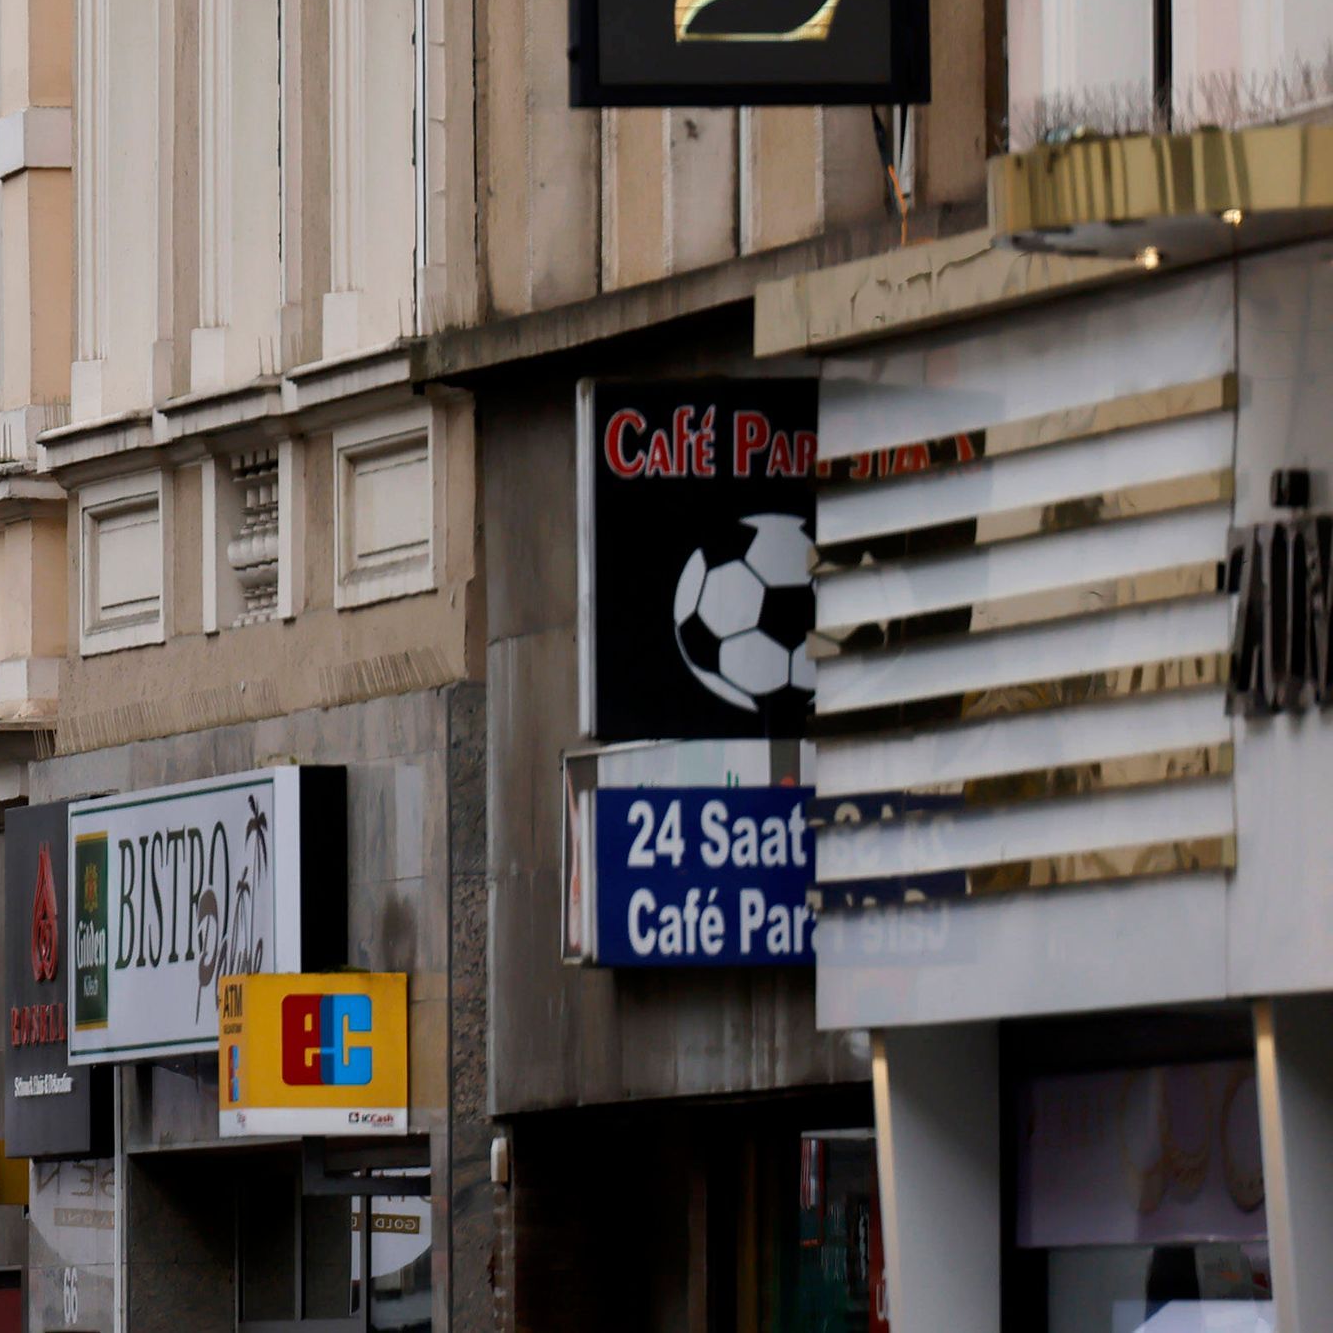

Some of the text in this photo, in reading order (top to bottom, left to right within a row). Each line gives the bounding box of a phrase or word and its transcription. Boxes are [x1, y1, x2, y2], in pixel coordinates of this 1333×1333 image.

[627, 799, 807, 868] 24 Saat
[115, 821, 230, 970] BISTRO
[628, 887, 725, 957] Café
[63, 1267, 78, 1324] 66
